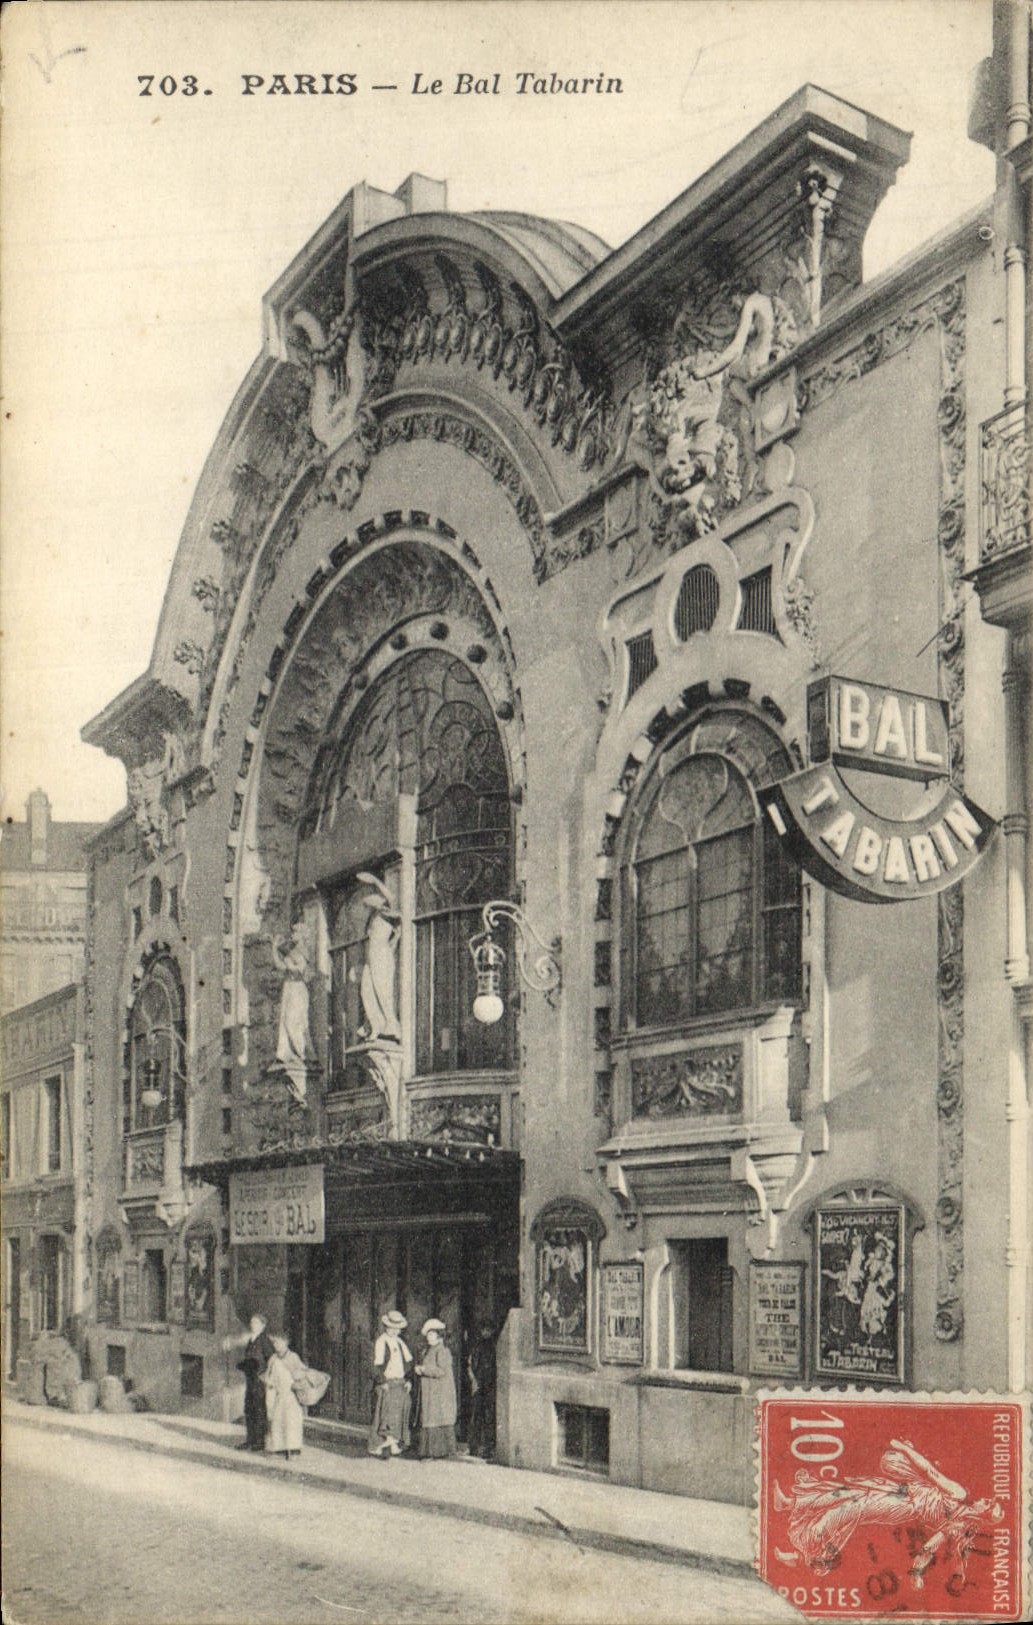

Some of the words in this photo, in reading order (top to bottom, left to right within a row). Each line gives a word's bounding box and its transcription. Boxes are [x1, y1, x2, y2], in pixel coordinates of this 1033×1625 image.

[840, 684, 943, 765] BAL
[802, 776, 983, 884] TABARIN
[286, 1204, 317, 1236] BAL
[992, 1412, 1011, 1501] REPUBLIQUE
[992, 1527, 1011, 1611] FRANÇAISE
